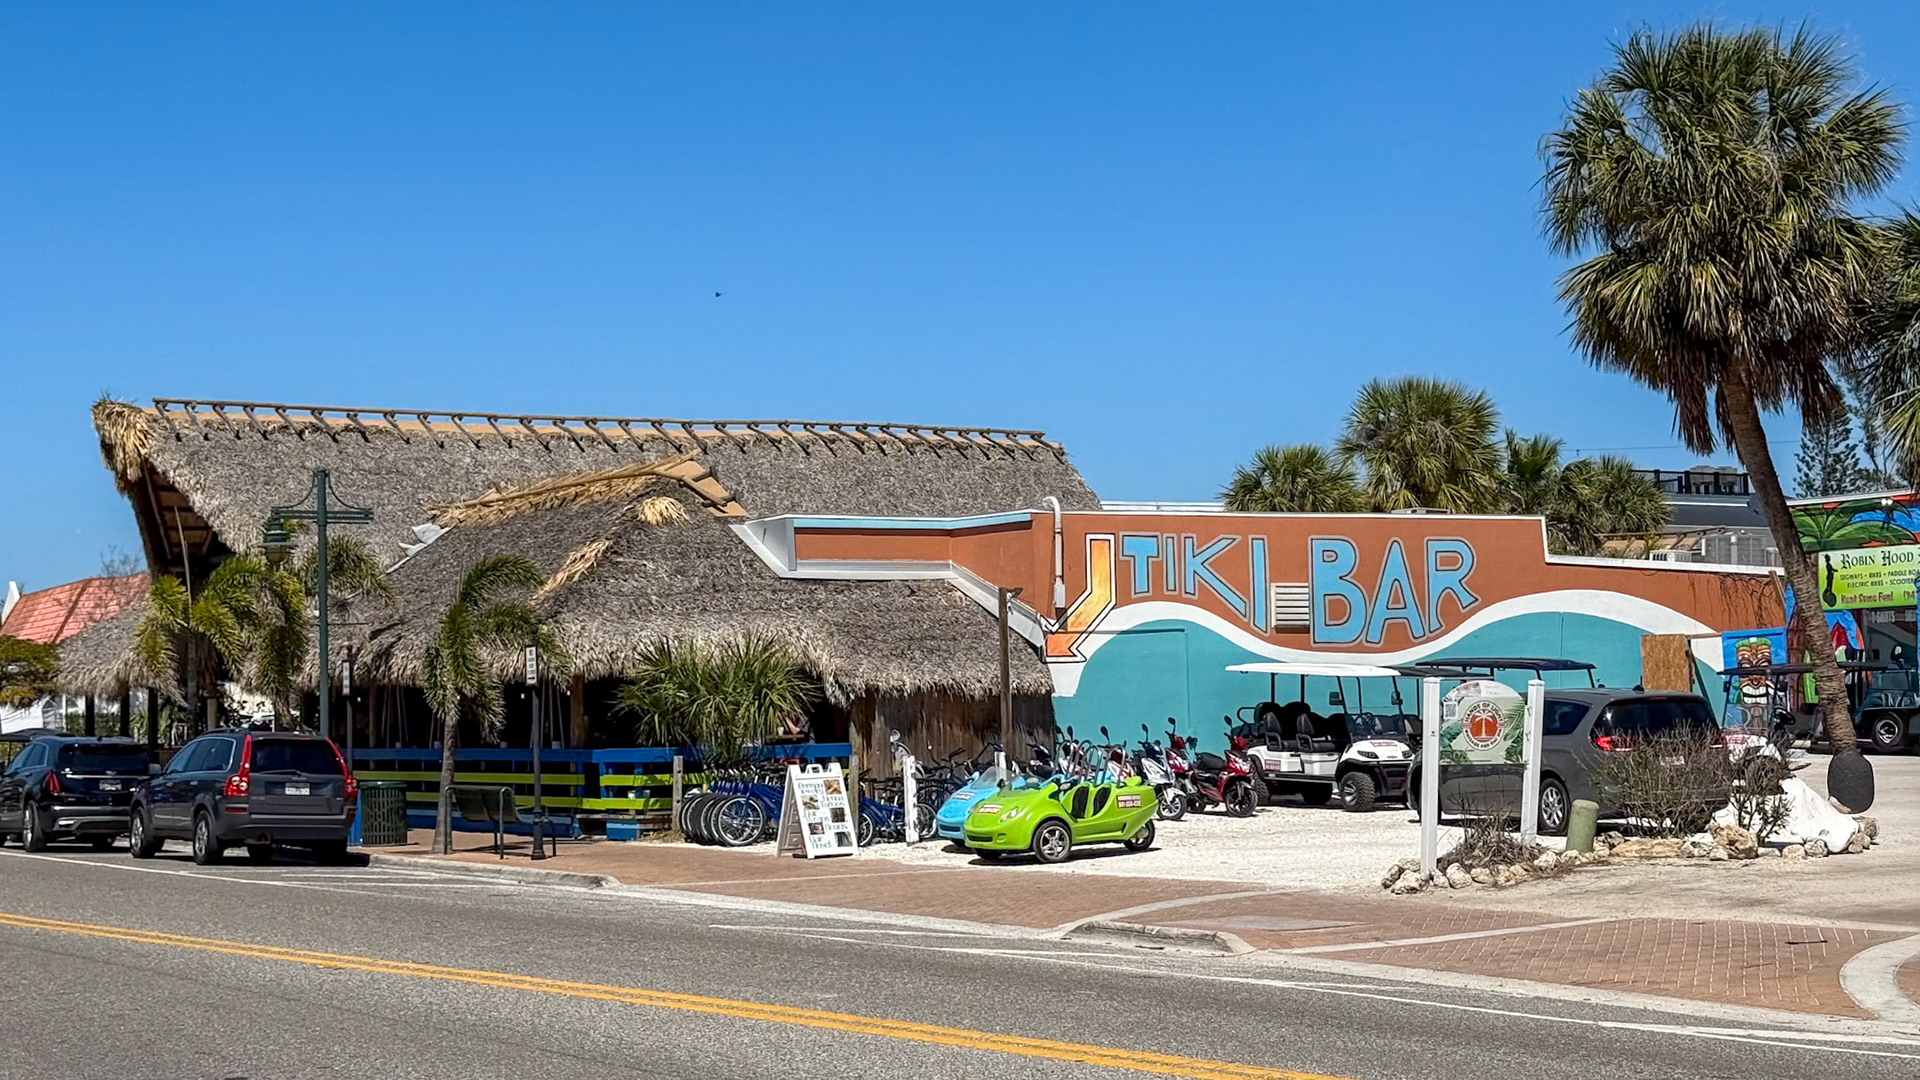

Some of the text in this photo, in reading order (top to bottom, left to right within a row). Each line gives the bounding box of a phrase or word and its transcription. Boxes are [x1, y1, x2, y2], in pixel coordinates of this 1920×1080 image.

[1840, 553, 1875, 569] ROBIN
[1881, 550, 1914, 566] HOOD
[1119, 532, 1480, 647] TIKI BAR
[1840, 594, 1857, 604] Rent
[1858, 593, 1877, 602] Some
[1465, 704, 1481, 722] HANDS
[1491, 705, 1503, 721] LIGHT
